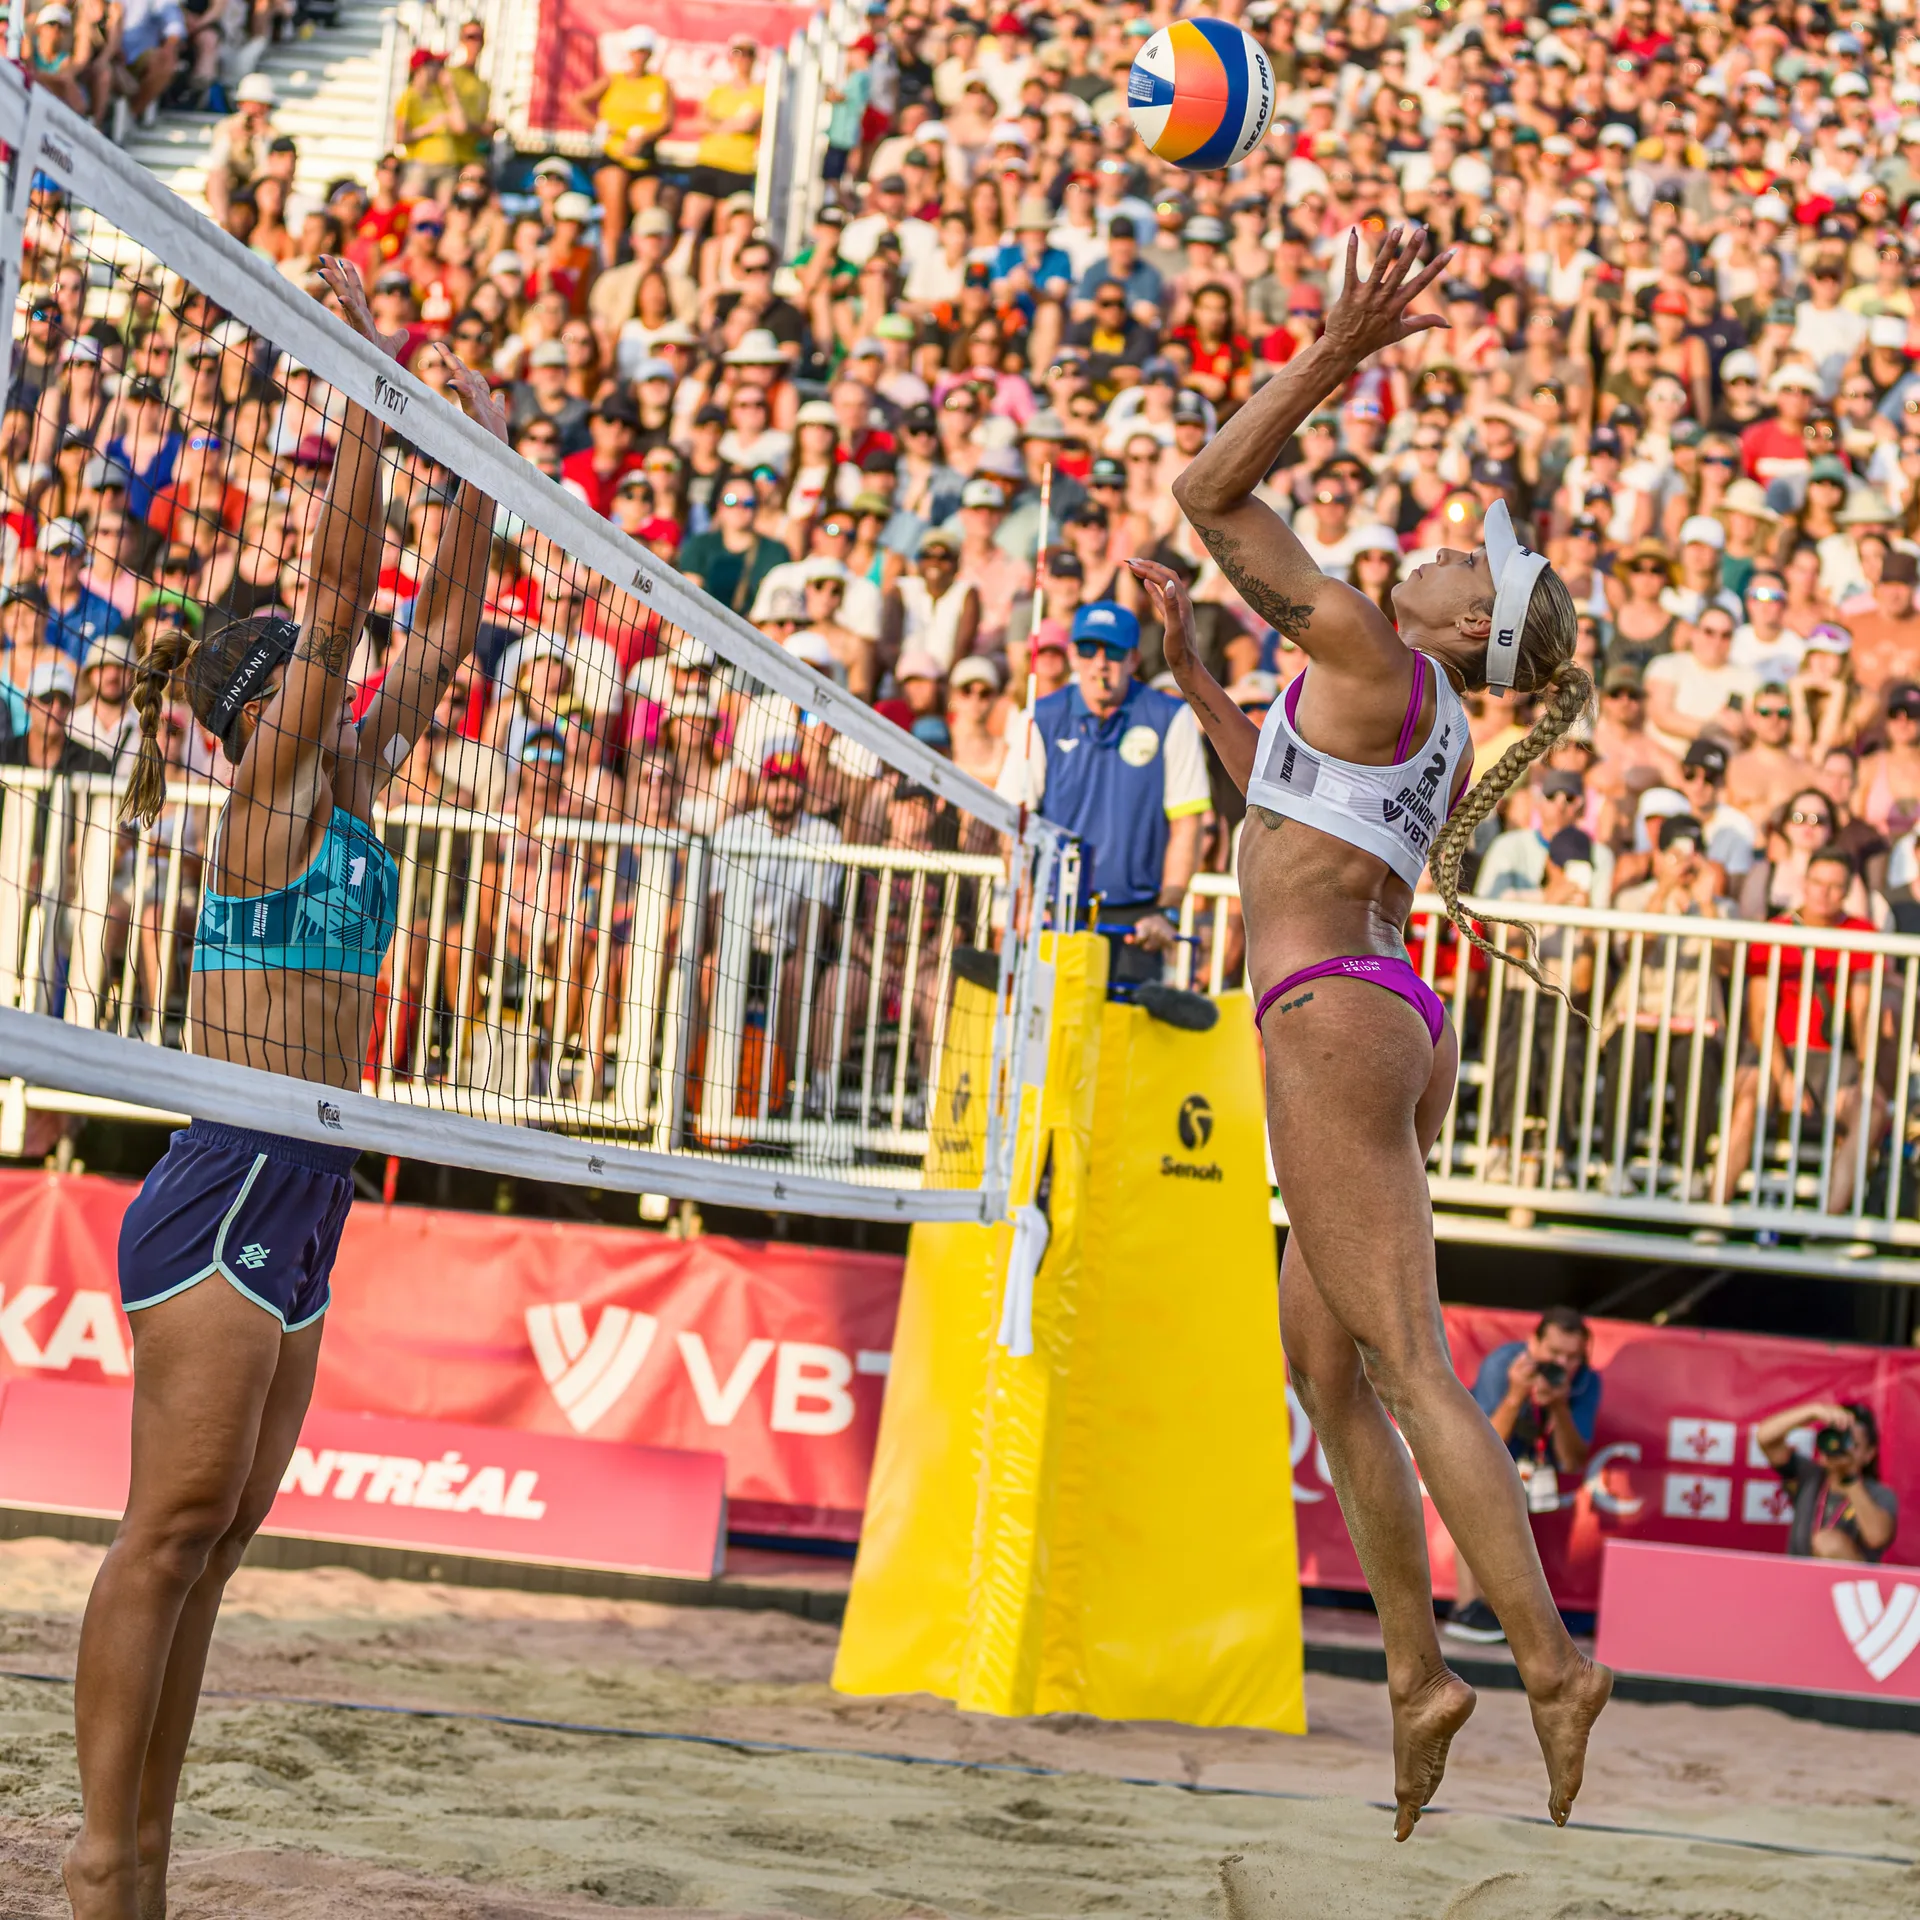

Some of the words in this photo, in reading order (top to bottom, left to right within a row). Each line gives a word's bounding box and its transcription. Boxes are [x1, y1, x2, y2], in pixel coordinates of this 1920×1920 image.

[1255, 53, 1269, 92] PRO
[1243, 94, 1269, 151] BEACH
[222, 649, 270, 711] ZINZANE
[1422, 752, 1447, 789] 2
[1395, 787, 1437, 831] BRANDIE
[1416, 776, 1436, 805] CAN
[348, 856, 367, 887] 1
[1161, 1154, 1223, 1183] Senoh
